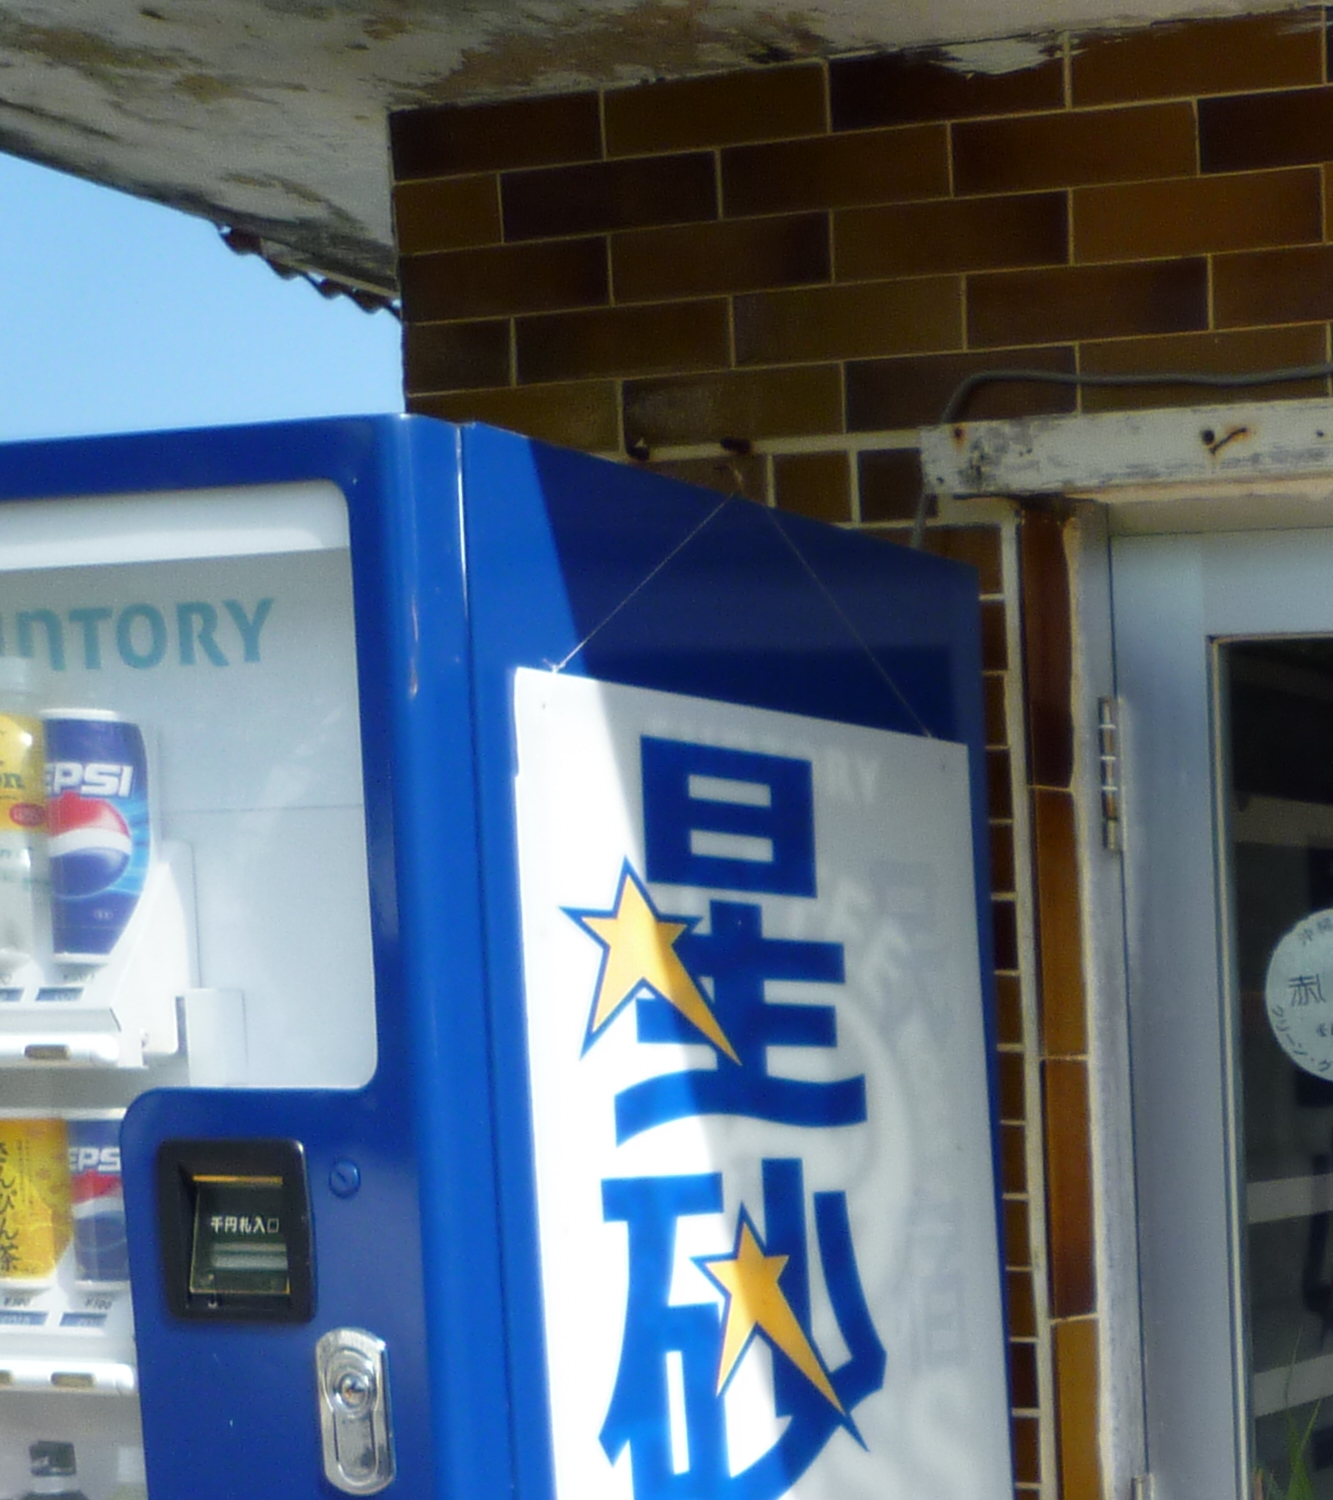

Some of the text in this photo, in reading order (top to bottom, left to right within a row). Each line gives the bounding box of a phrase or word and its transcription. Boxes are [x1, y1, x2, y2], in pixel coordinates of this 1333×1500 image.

[211, 1214, 280, 1234] 千円札入口
